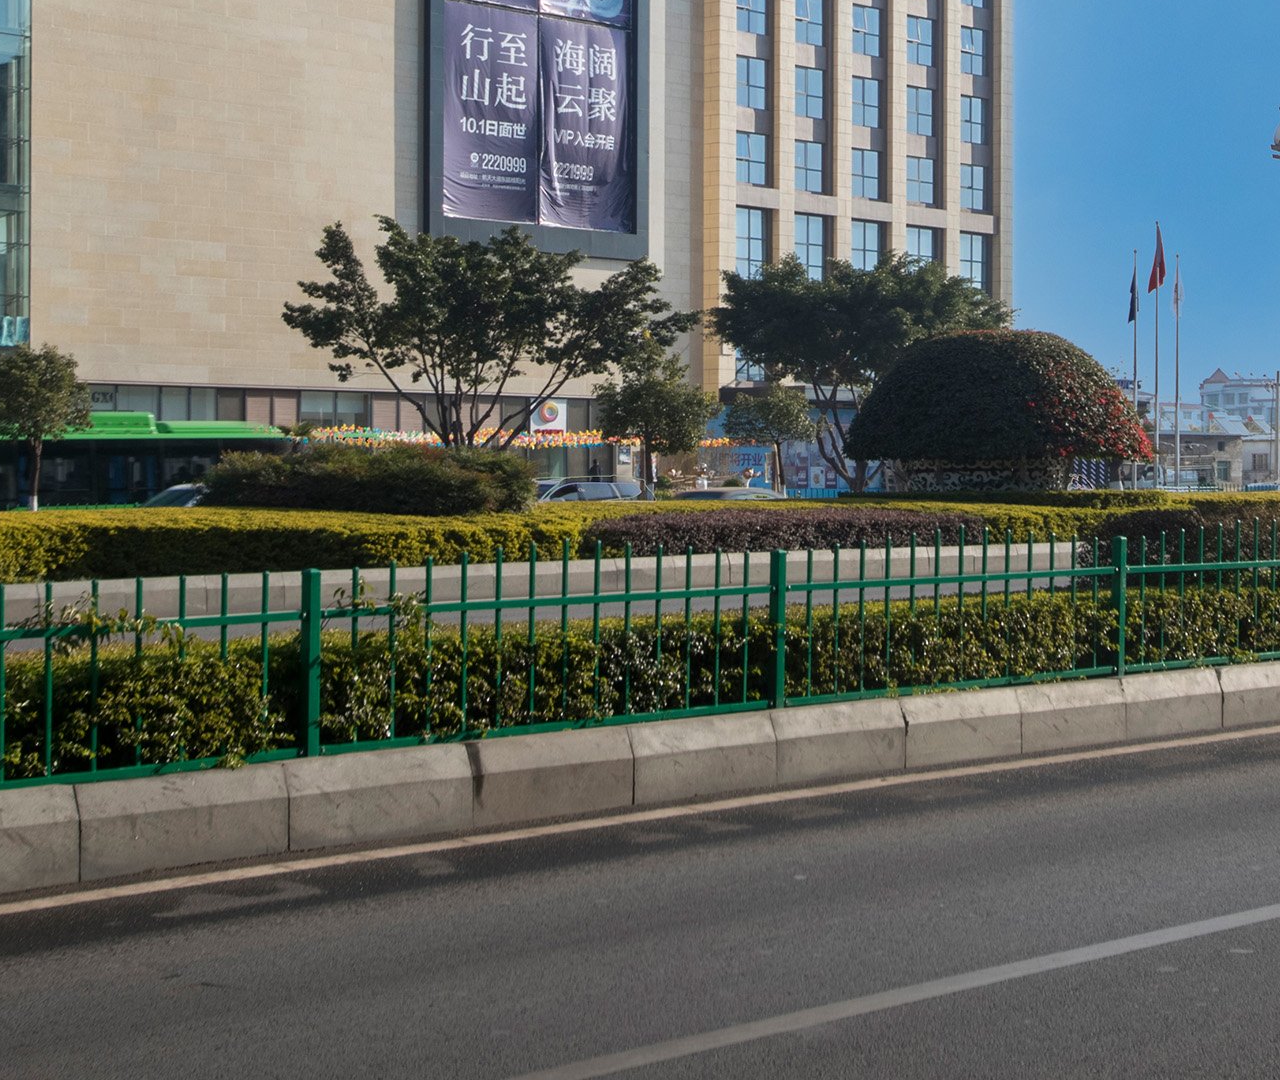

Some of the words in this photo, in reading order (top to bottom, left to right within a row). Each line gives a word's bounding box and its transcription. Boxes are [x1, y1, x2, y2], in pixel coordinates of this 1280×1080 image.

[460, 116, 527, 140] 10.1日面世
[482, 153, 527, 173] 2220999
